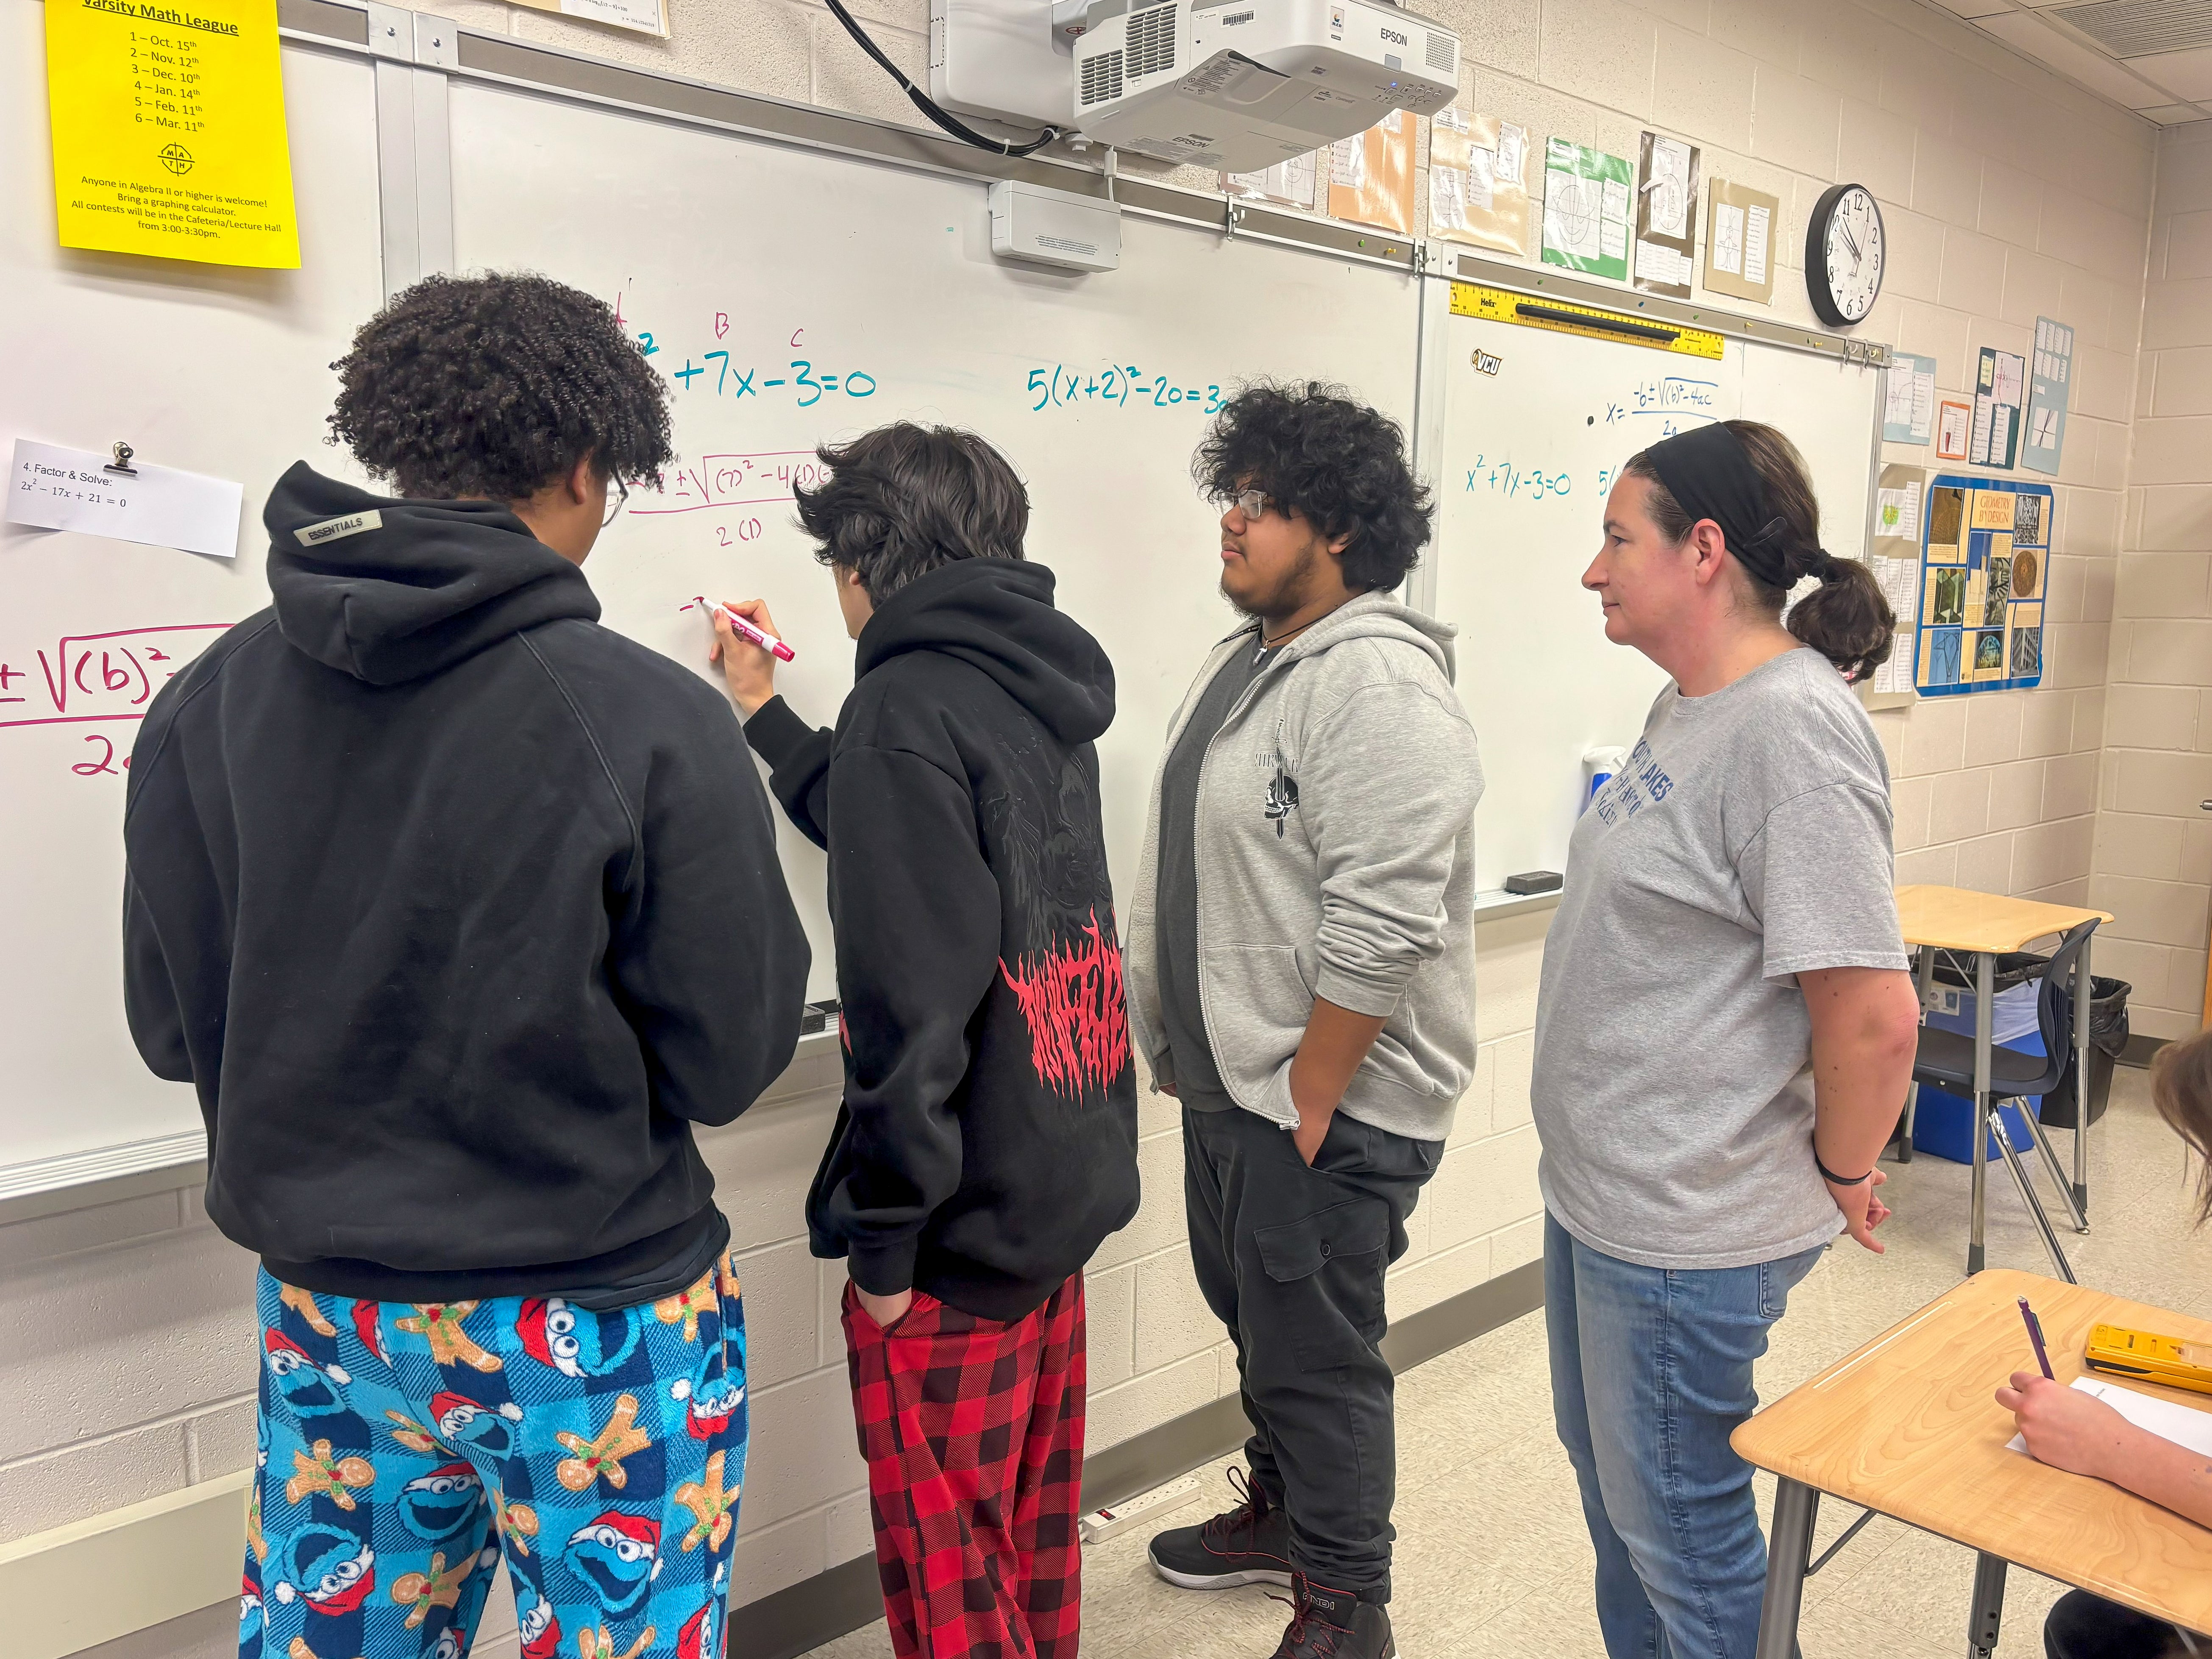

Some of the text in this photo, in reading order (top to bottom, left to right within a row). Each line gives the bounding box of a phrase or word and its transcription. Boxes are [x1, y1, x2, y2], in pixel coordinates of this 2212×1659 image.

[140, 4, 181, 23] Math
[186, 13, 238, 34] League
[130, 32, 136, 41] 1
[150, 36, 173, 48] Oct.
[1381, 28, 1407, 46] EPSON
[131, 47, 137, 58] 2
[151, 51, 175, 64] Nov.
[132, 64, 139, 73] 3
[153, 67, 176, 81] Dec.
[134, 81, 142, 90] 4
[155, 84, 176, 96] Jan.
[135, 97, 142, 106] 5
[156, 100, 178, 113] Feb.
[135, 113, 142, 122] 6
[156, 116, 181, 129] Mar.
[1172, 137, 1210, 148] EPSON
[81, 176, 116, 187] Anyone
[130, 183, 163, 194] Algebra
[186, 190, 214, 200] higher
[217, 194, 222, 202] is
[225, 197, 267, 207] welcome!
[118, 193, 141, 205] Bring
[151, 200, 189, 212] graphing
[192, 205, 236, 216] calculator.
[1843, 198, 1849, 215] 11
[1854, 193, 1862, 211] 12
[72, 200, 83, 209] All
[86, 203, 125, 213] contests
[127, 208, 142, 216] will
[145, 209, 156, 218] be
[169, 213, 184, 222] the
[185, 215, 262, 231] Cafeteria/Lecture
[264, 224, 281, 232] Hall
[1866, 206, 1869, 222] 1
[138, 220, 220, 239] from 3:00-3:30pm.
[1872, 227, 1877, 244] 2
[1827, 240, 1833, 256] 9
[1873, 254, 1878, 270] 3
[1828, 266, 1834, 283] 8
[1868, 278, 1873, 294] 4
[1481, 298, 1494, 308] Helix
[1837, 289, 1842, 306] 7
[1858, 295, 1863, 312] 5
[1847, 299, 1853, 316] 6
[1476, 349, 1502, 375] VCU
[23, 462, 112, 487] 4. Factor & Solve:
[52, 487, 71, 497] 17x
[88, 493, 101, 503] 21
[120, 499, 126, 507] 0
[1980, 495, 2011, 510] GEOMETRY
[1979, 510, 2009, 523] BY DESIGN
[308, 518, 363, 540] ESSENTIALS
[71, 735, 131, 776] 2
